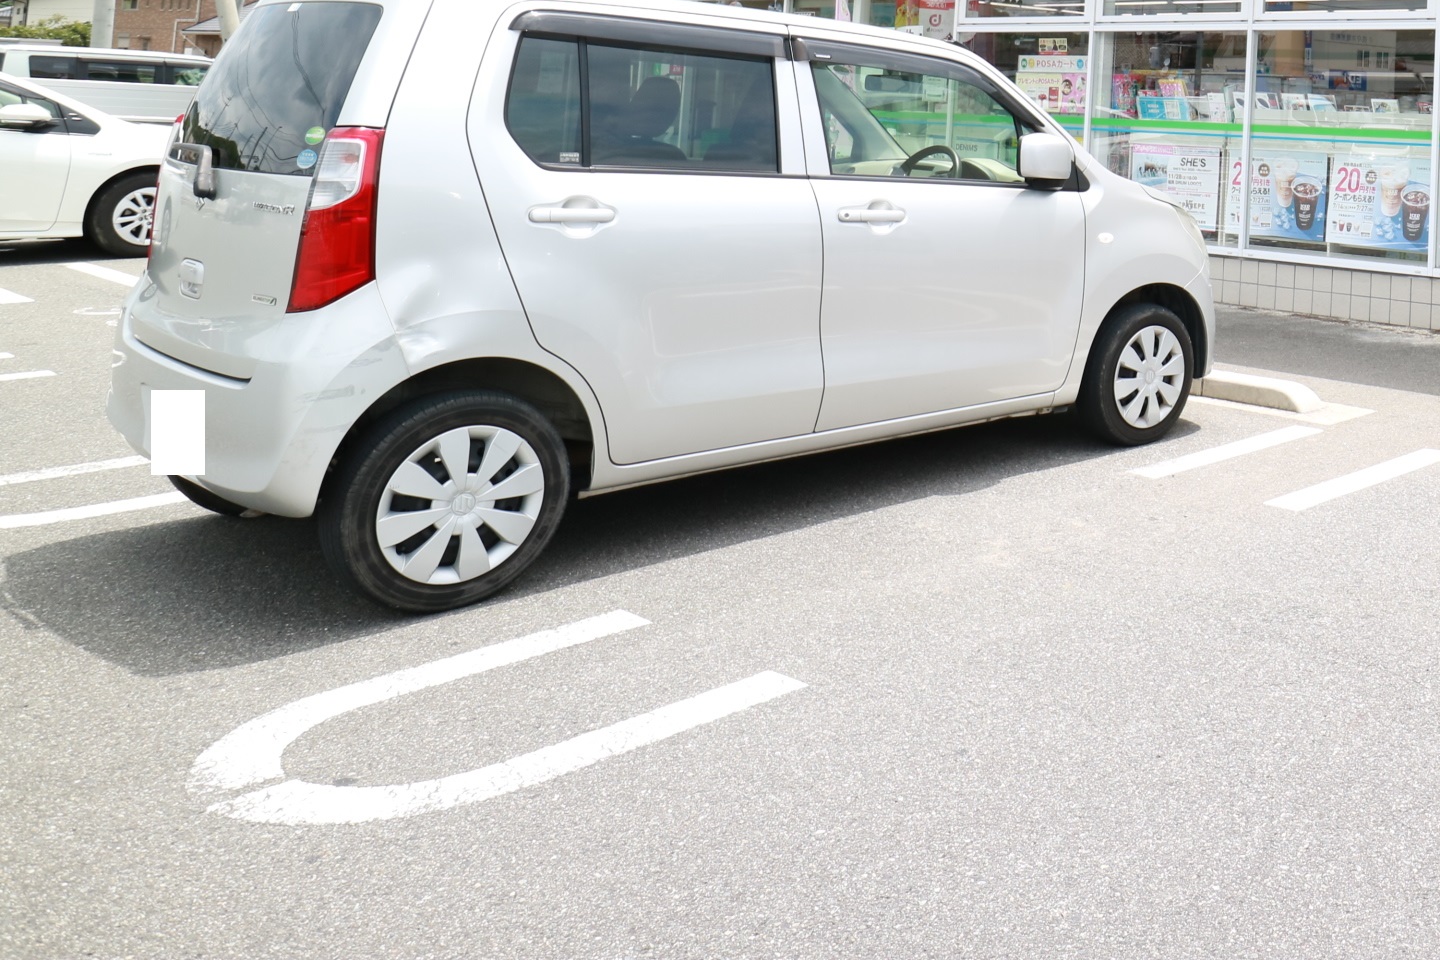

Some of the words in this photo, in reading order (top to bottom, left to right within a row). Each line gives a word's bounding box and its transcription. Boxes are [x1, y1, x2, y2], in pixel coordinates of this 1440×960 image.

[1036, 59, 1075, 68] POSAカード
[1180, 157, 1207, 168] SHE'S
